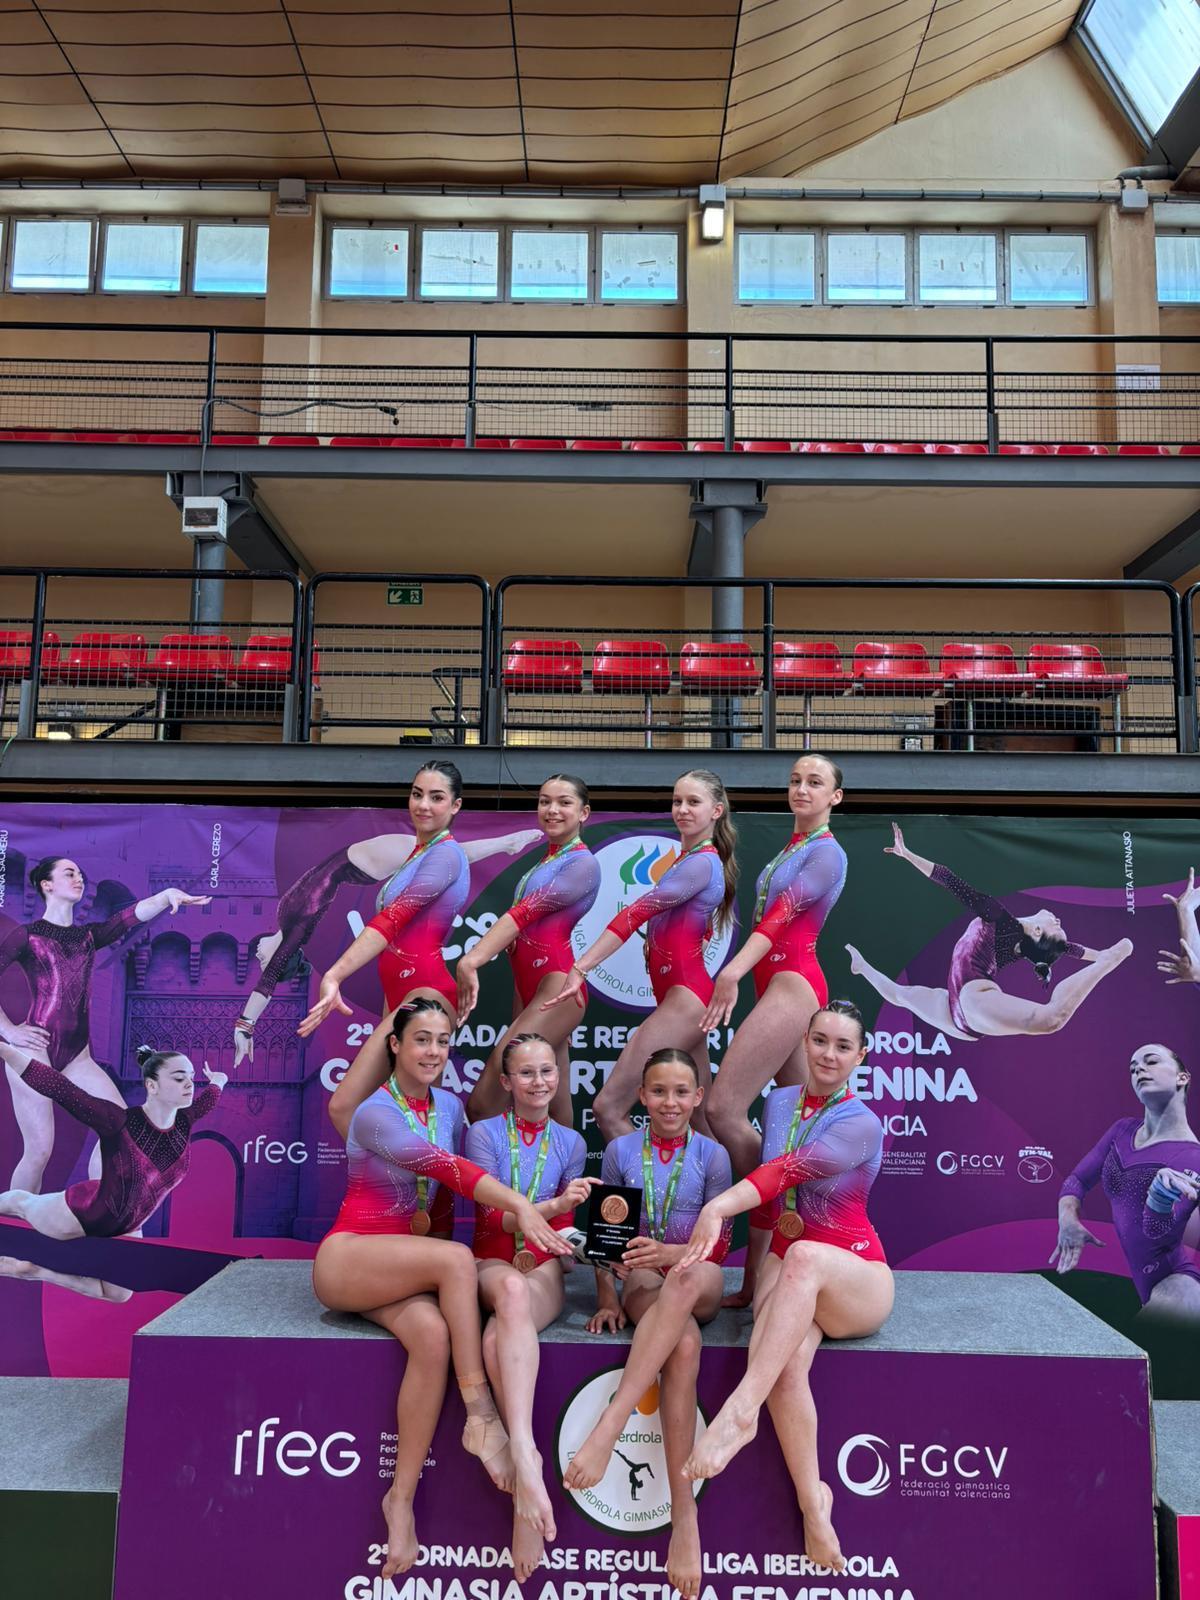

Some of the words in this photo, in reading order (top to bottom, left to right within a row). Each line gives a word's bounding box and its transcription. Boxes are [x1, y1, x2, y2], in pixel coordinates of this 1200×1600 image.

[212, 823, 221, 857] CEREZO
[1123, 831, 1134, 879] ATTANASIO
[210, 858, 219, 888] CARLA
[1125, 880, 1135, 915] JULIETA
[346, 1023, 374, 1047] 2ª
[865, 1031, 952, 1056] DROLA
[849, 1065, 978, 1103] ENINA
[960, 1154, 1004, 1168] FGCV
[380, 1432, 399, 1441] Rea
[619, 1430, 662, 1444] erdrola
[899, 1443, 1009, 1479] FGCV
[900, 1489, 950, 1497] comunitat
[954, 1490, 1011, 1499] valenciana
[623, 1502, 672, 1522] GIMNASIA
[414, 1544, 515, 1568] ORNADA
[537, 1548, 580, 1570] ASE
[584, 1549, 669, 1572] REGUL
[703, 1552, 759, 1575] LIGA
[537, 1571, 720, 1600] ARTÍSTIA
